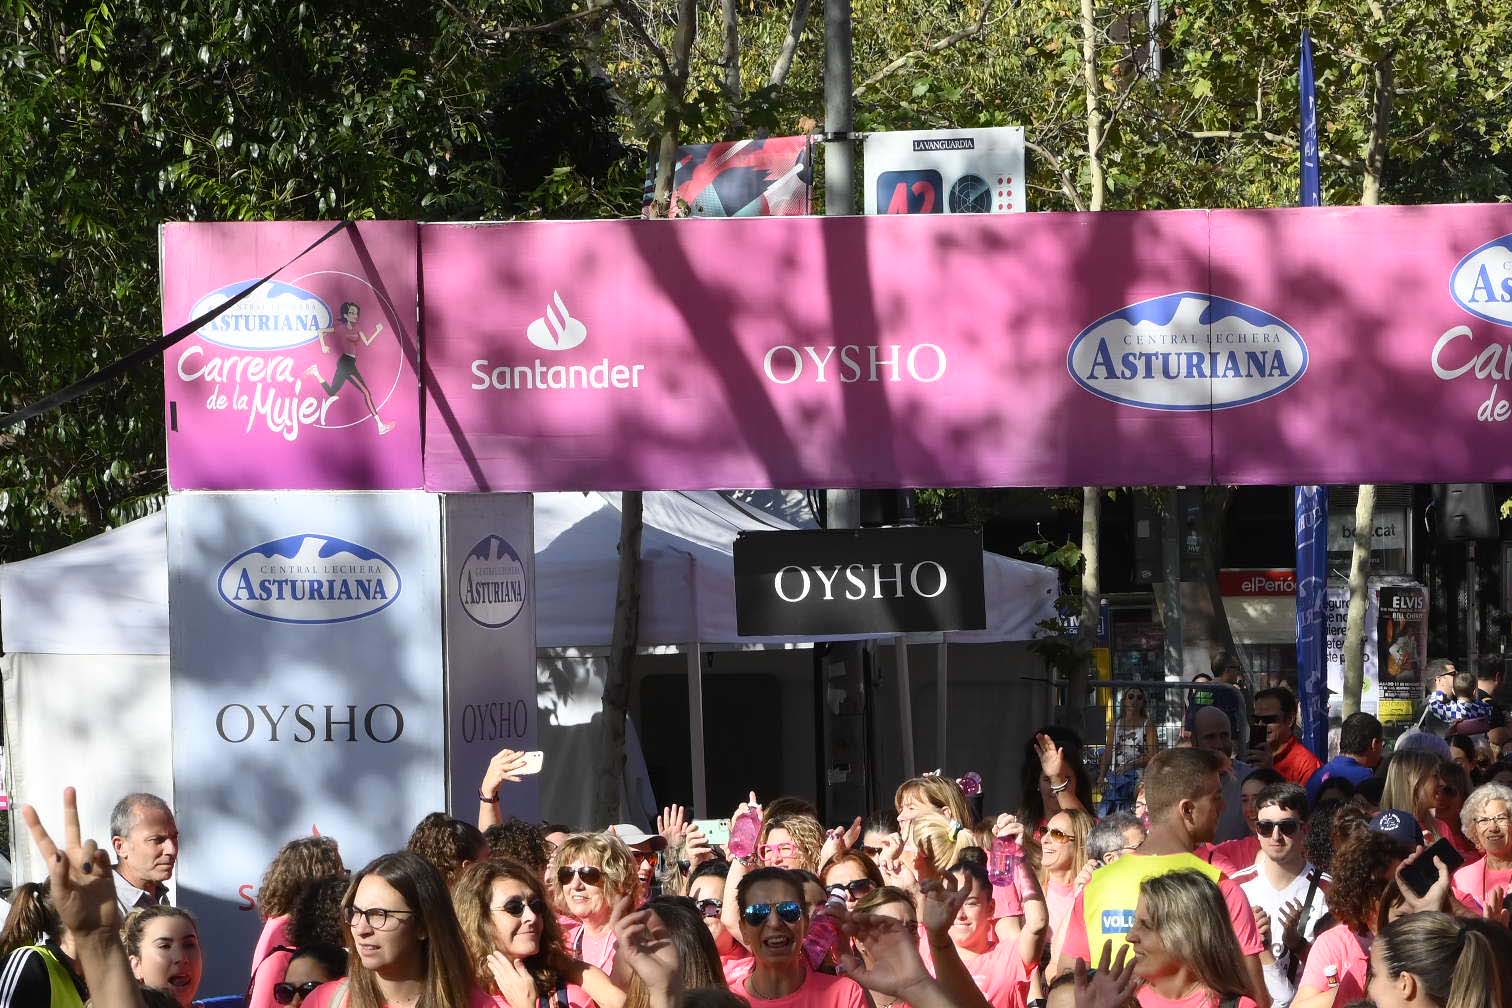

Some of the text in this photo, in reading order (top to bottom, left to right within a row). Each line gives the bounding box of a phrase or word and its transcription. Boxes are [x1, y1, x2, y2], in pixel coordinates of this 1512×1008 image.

[926, 139, 973, 149] VANGUARDIA
[1123, 332, 1281, 346] CENTRAL LECHERA
[177, 346, 294, 382] Carrera
[470, 359, 645, 391] Santander
[763, 343, 947, 384] OYSHO
[1087, 338, 1290, 380] ASTURIANA
[206, 378, 339, 441] de la Mujer
[1476, 384, 1510, 422] de
[233, 567, 388, 601] ASTURIANA
[261, 566, 382, 574] CENTRAL LECHERA
[774, 560, 947, 602] OYSHO
[464, 571, 522, 606] ASTURIANA
[1392, 595, 1423, 608] ELVIS
[215, 704, 405, 743] OYSHO
[462, 700, 528, 743] OYSHO
